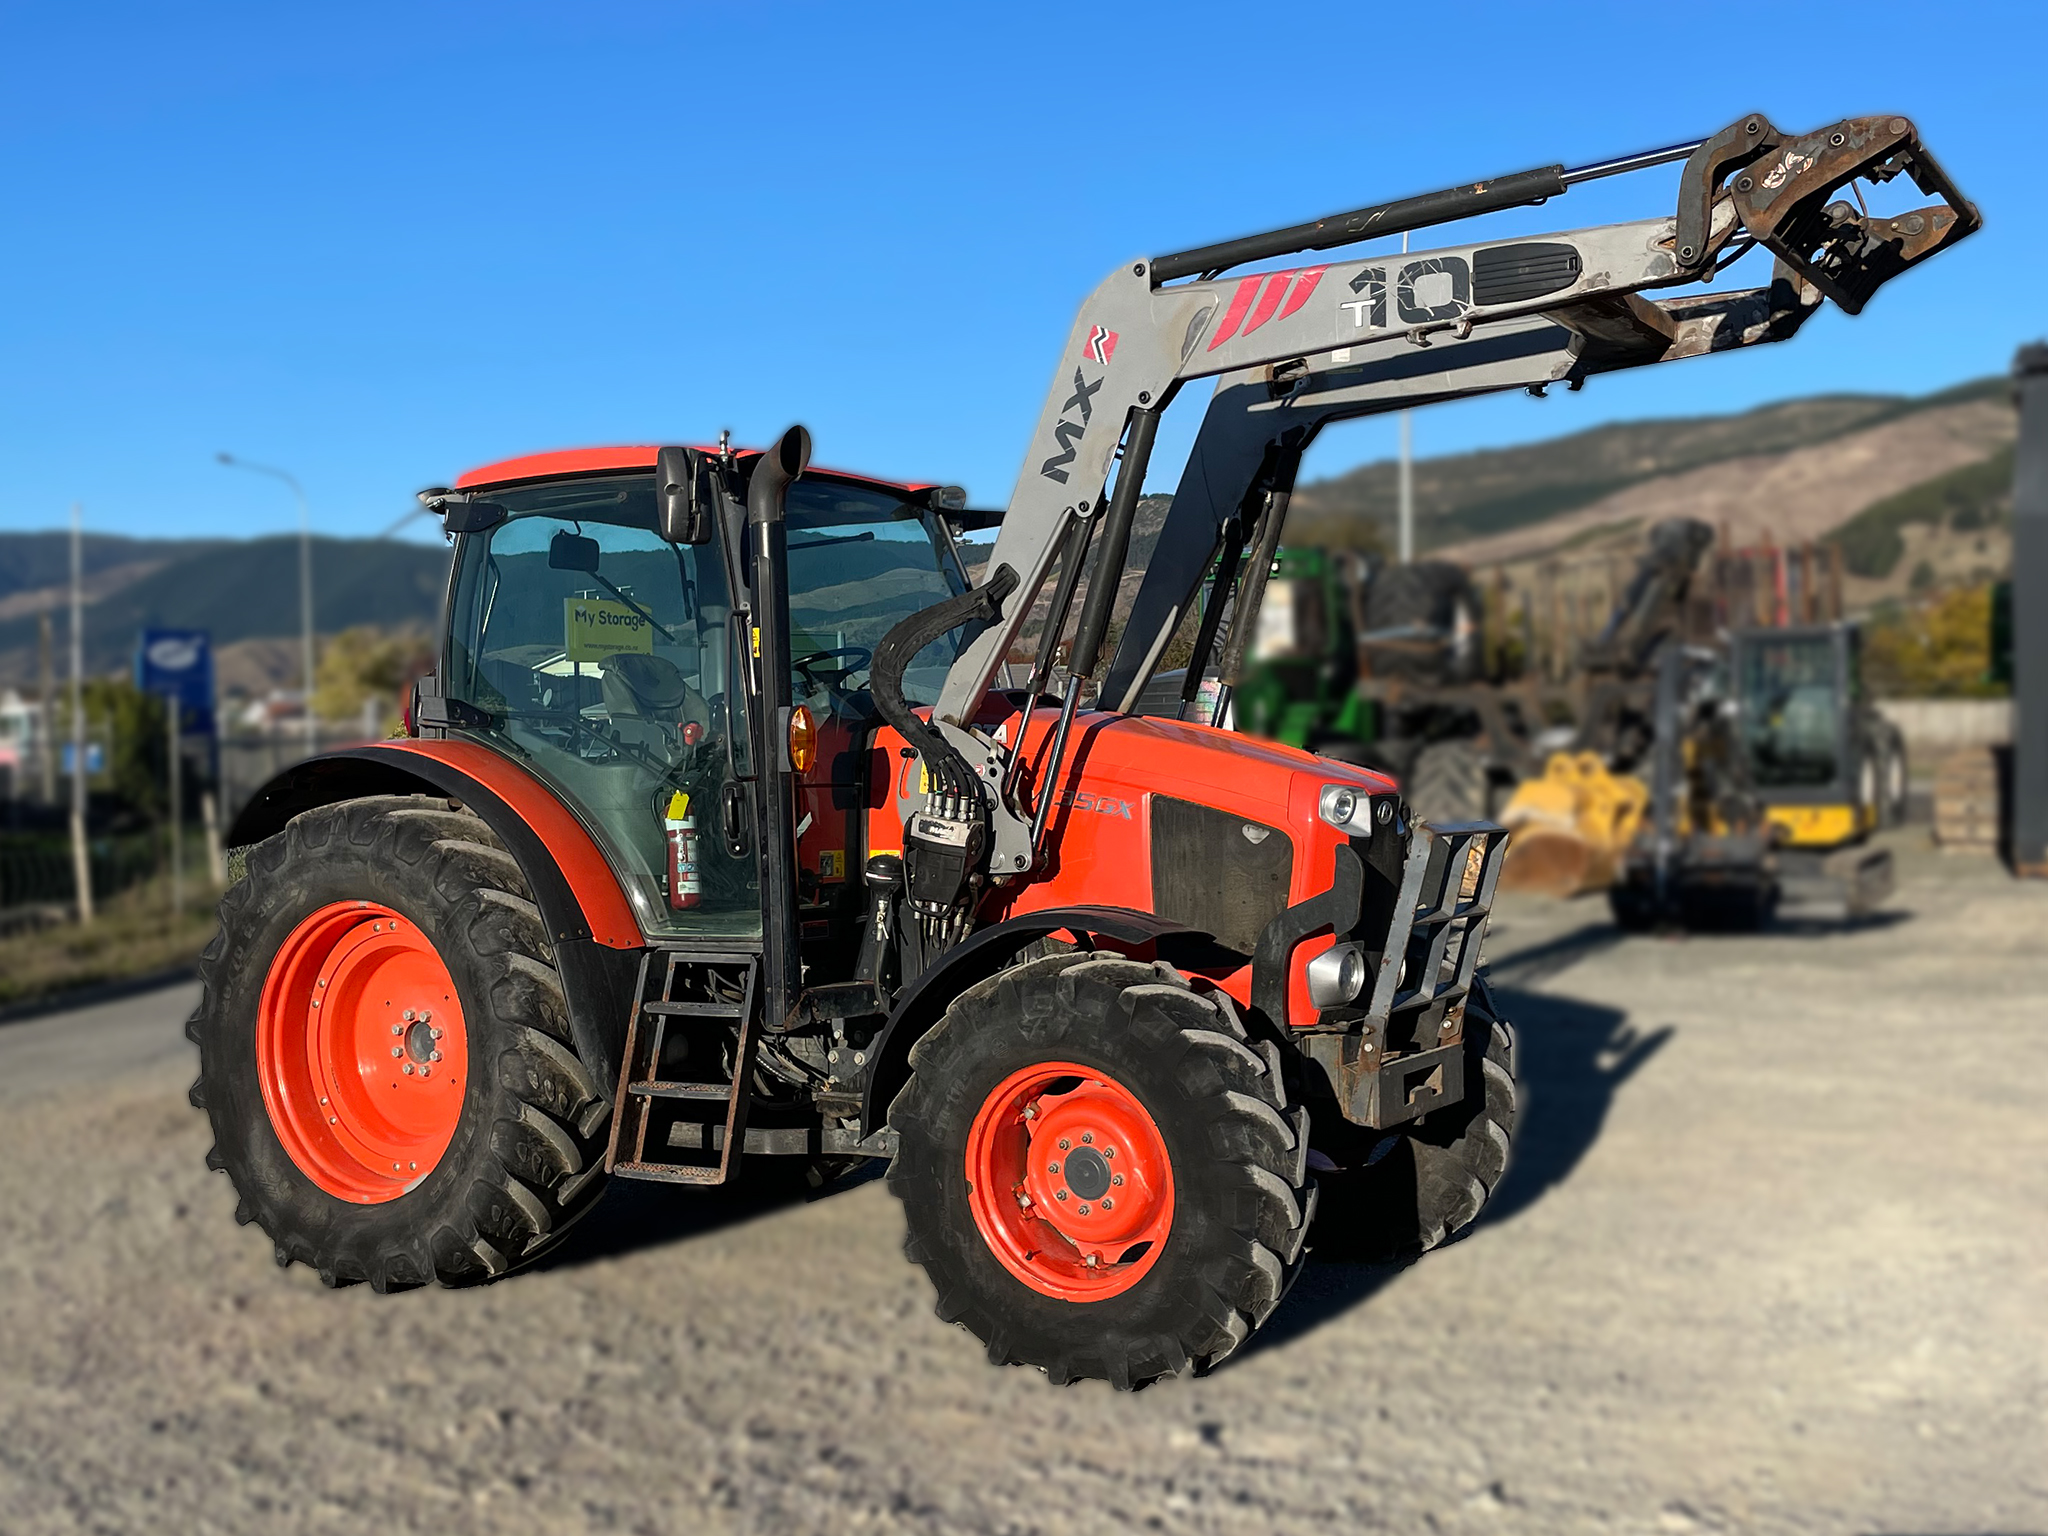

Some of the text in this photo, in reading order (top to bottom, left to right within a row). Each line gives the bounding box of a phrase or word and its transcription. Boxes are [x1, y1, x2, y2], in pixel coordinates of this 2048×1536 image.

[1040, 365, 1105, 485] MX
[575, 609, 646, 632] My Storage
